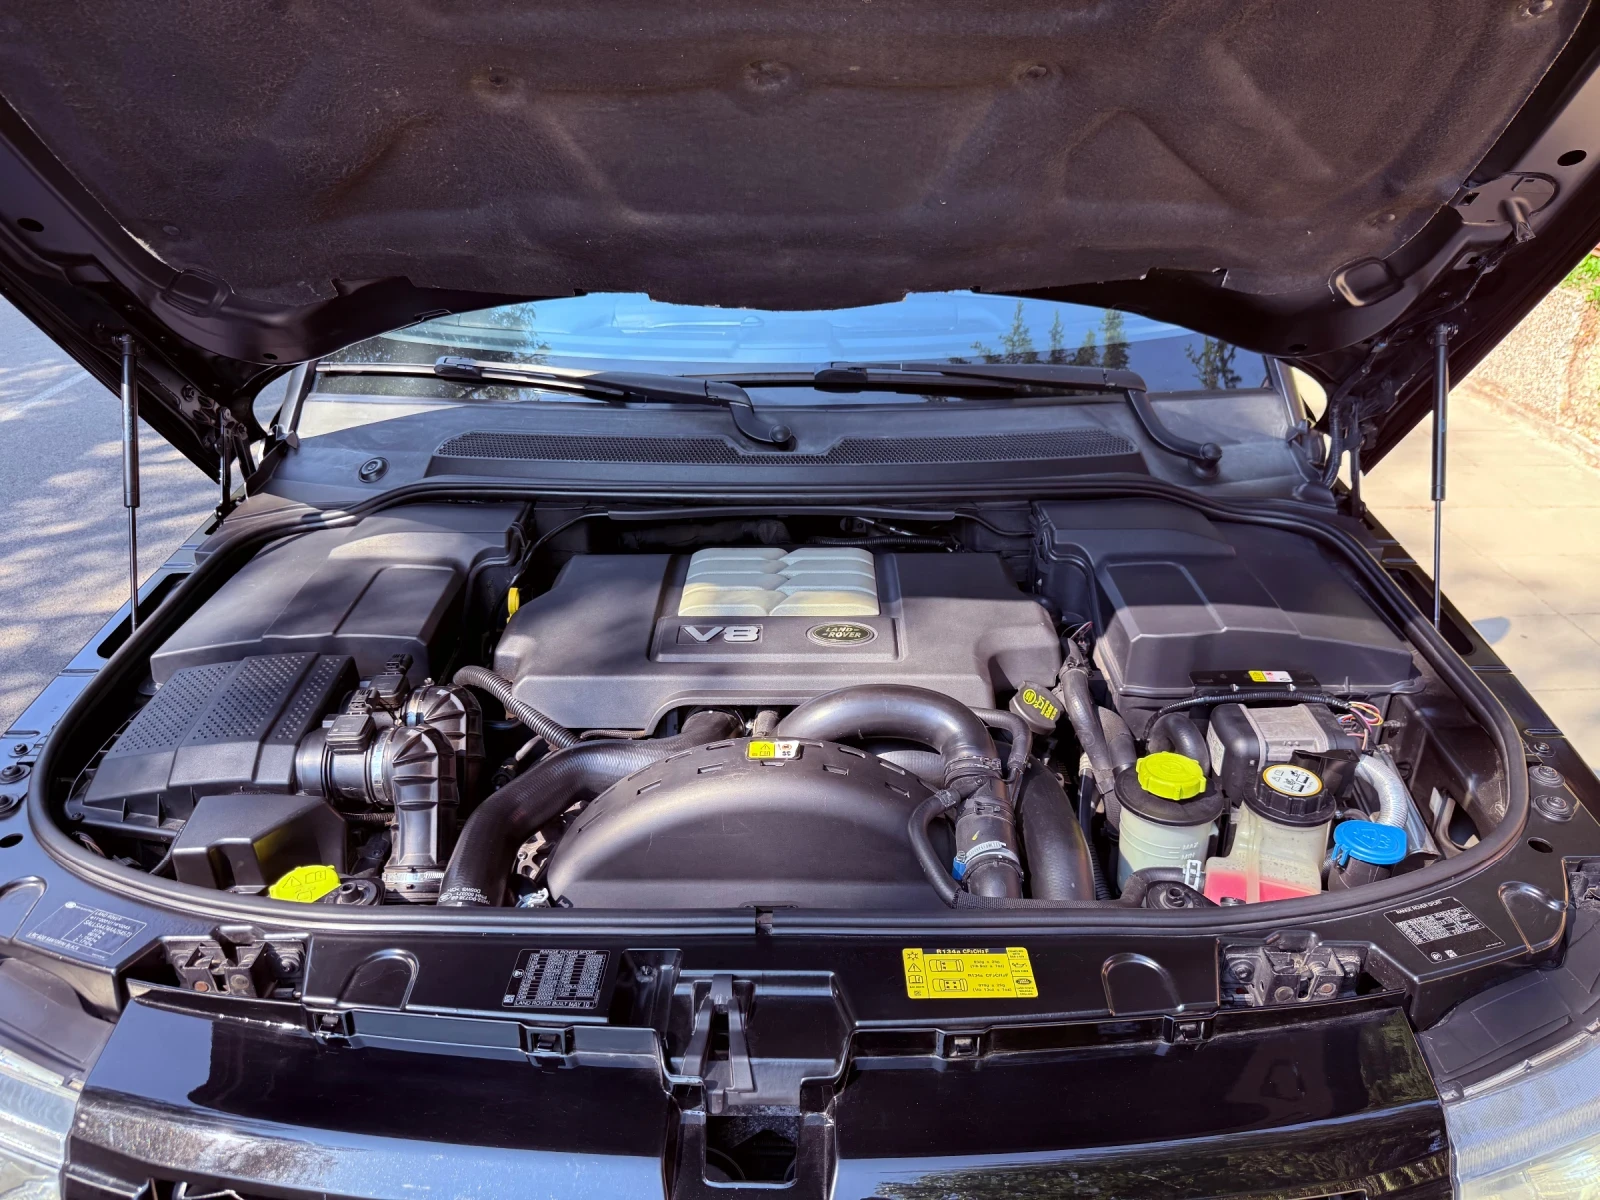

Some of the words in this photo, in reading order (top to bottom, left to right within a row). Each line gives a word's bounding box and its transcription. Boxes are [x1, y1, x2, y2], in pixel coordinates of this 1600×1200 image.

[683, 626, 759, 643] V8
[829, 631, 862, 639] ROVER
[1182, 842, 1199, 850] MAX
